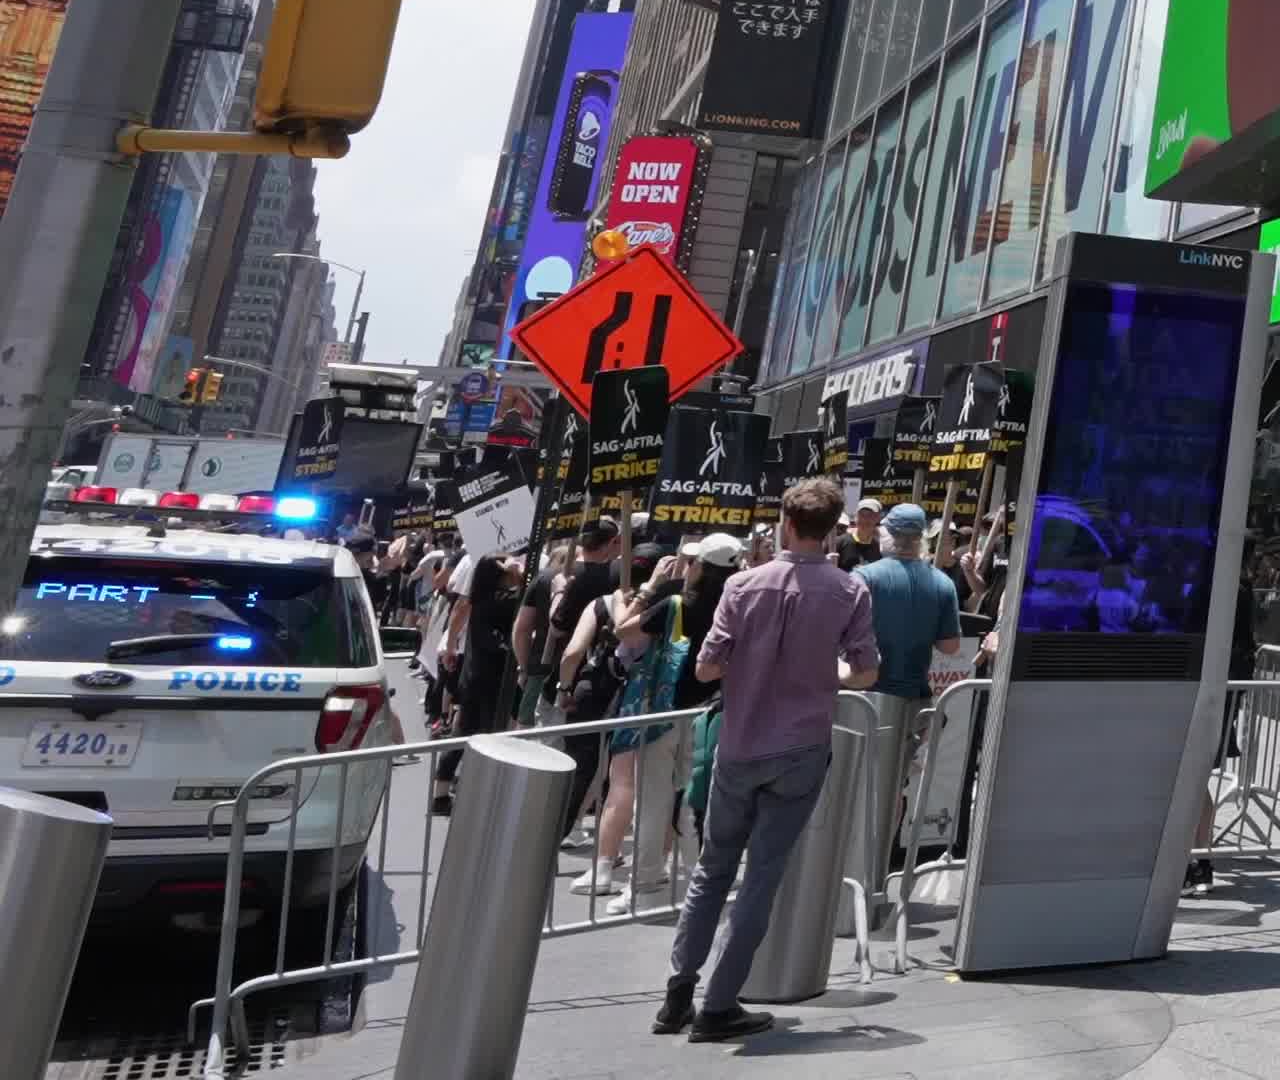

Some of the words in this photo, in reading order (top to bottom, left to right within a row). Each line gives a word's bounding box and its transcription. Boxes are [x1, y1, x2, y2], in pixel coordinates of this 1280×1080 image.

[732, 1, 819, 24] ここで入手
[739, 19, 808, 39] できます
[704, 114, 801, 130] LIONKING.COM
[575, 141, 597, 157] TACO
[628, 162, 682, 180] NOW
[621, 184, 679, 203] OPEN
[1179, 249, 1244, 269] LinkNYC
[654, 504, 751, 525] STRIKE!
[36, 582, 159, 603] PART
[168, 670, 304, 692] POLICE
[35, 733, 107, 755] 4420
